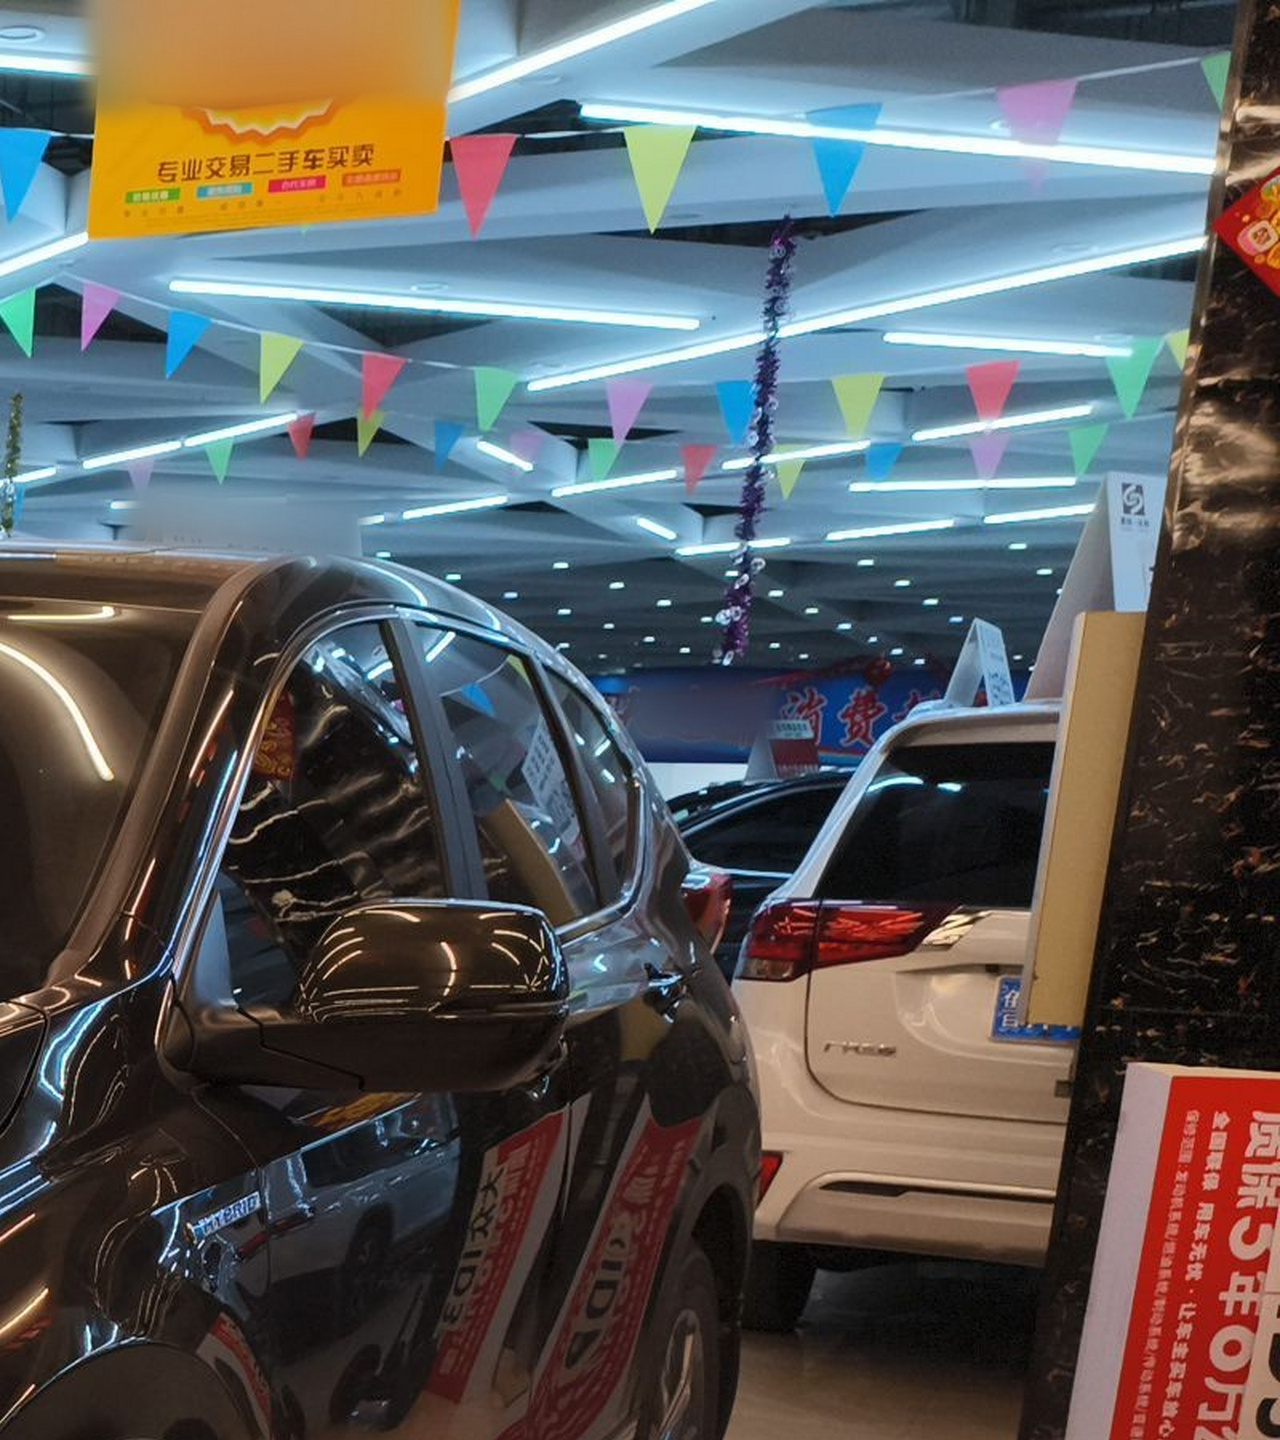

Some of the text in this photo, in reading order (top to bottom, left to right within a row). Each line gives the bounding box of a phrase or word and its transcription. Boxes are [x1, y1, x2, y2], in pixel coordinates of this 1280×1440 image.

[157, 143, 375, 183] 专业交易二手车买卖
[1201, 1110, 1231, 1191] 全国联保
